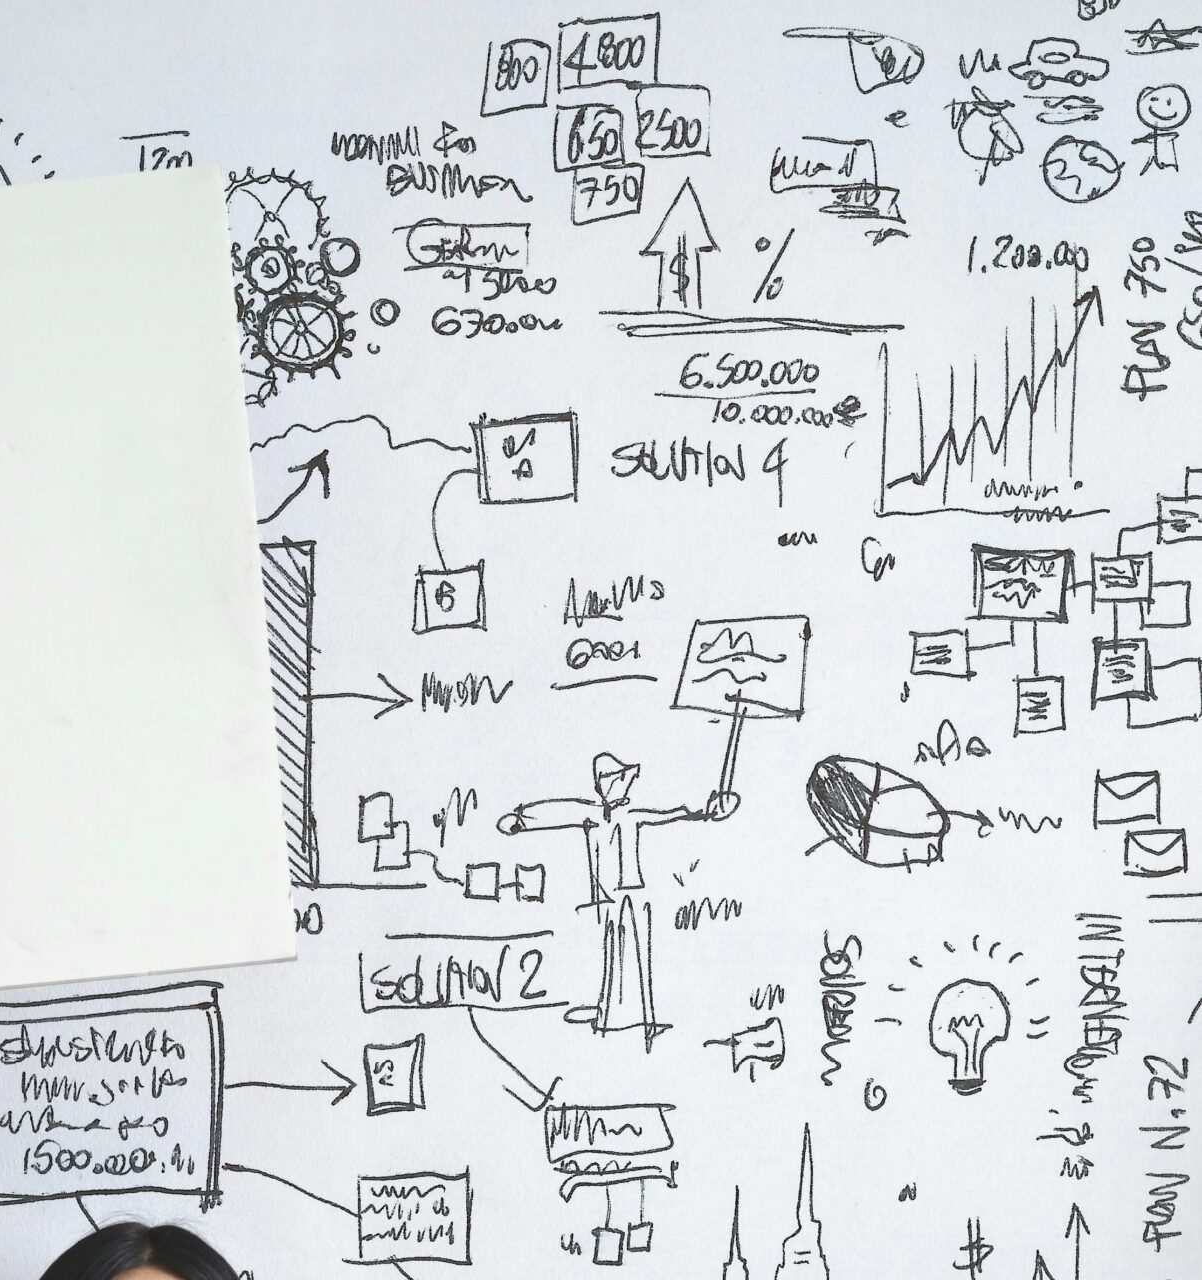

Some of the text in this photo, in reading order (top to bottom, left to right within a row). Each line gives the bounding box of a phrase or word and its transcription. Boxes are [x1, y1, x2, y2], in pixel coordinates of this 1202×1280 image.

[563, 31, 646, 86] 4800
[635, 107, 702, 151] 2500
[575, 174, 640, 210] 750
[679, 352, 820, 389] 6.500.000
[762, 437, 789, 508] 4
[434, 579, 456, 613] B
[519, 949, 548, 1000] 2
